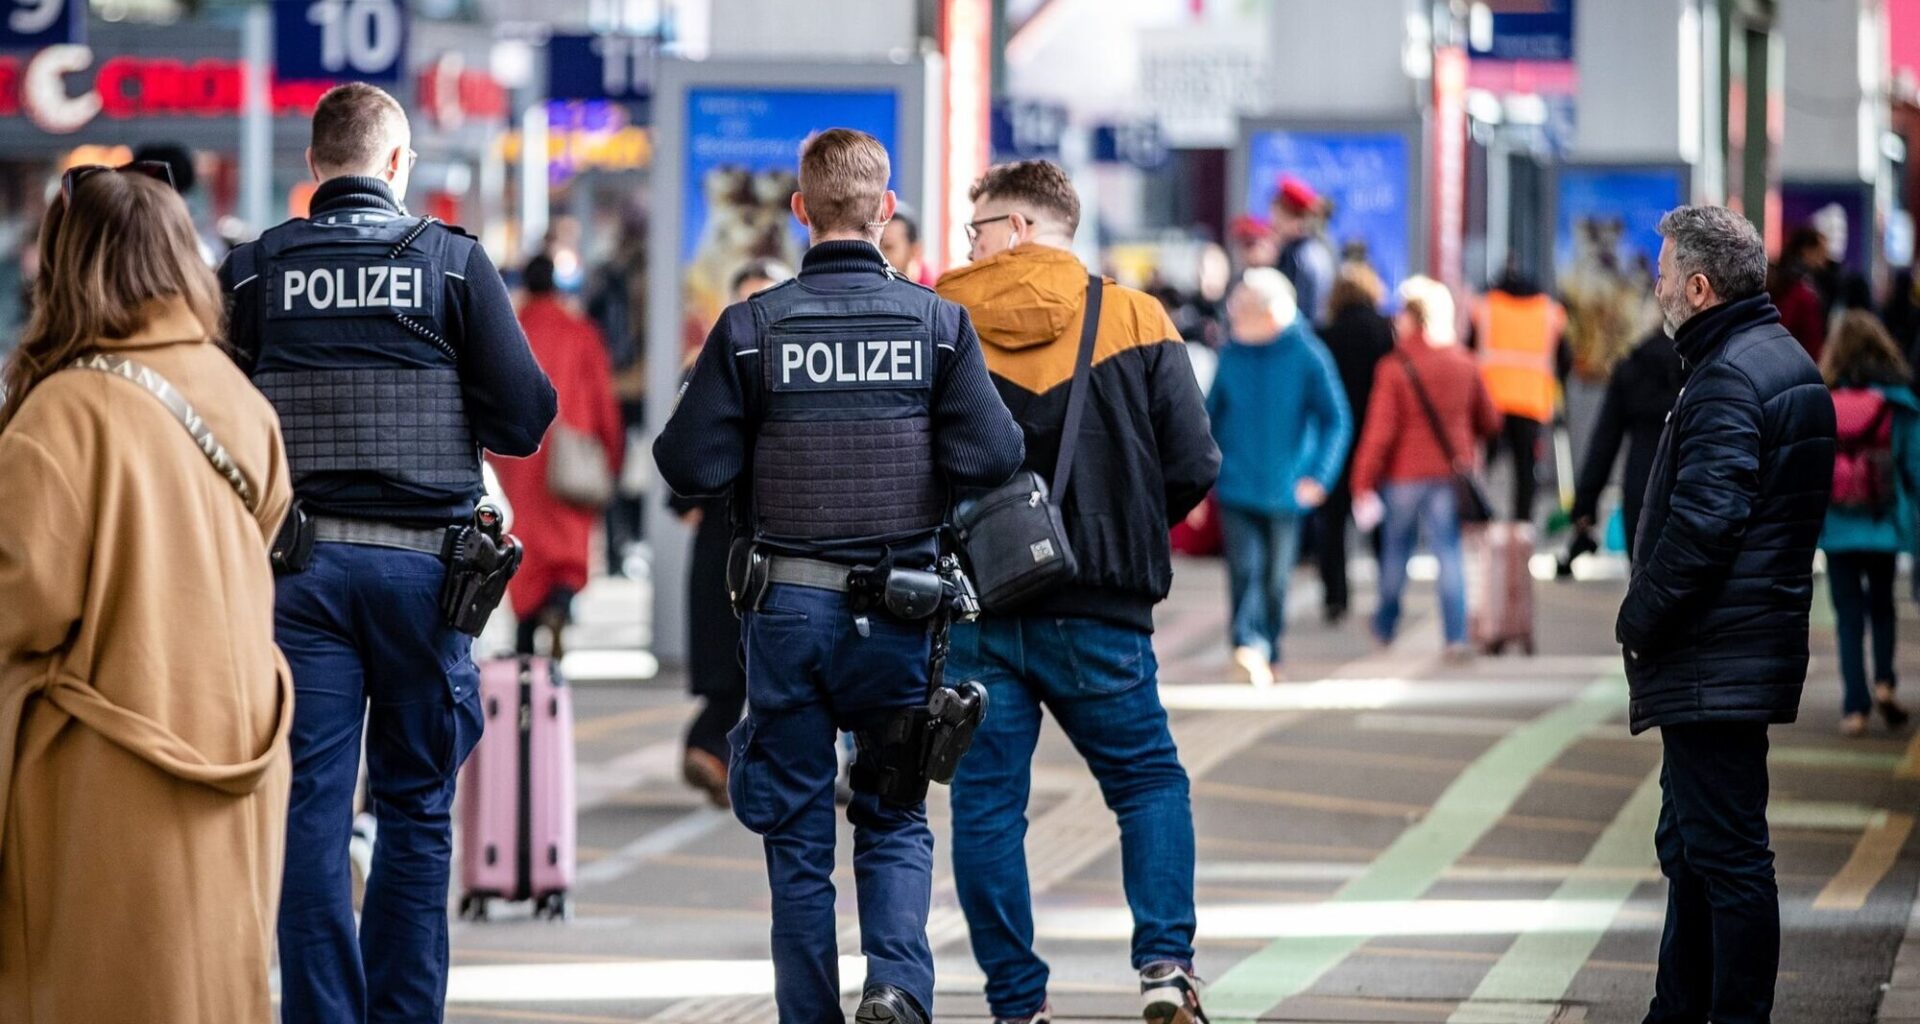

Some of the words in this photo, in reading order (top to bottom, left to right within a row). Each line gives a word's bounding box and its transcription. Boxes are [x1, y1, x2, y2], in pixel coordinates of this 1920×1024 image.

[305, 0, 401, 73] 10
[284, 266, 422, 311] POLIZEI
[782, 340, 922, 384] POLIZEI
